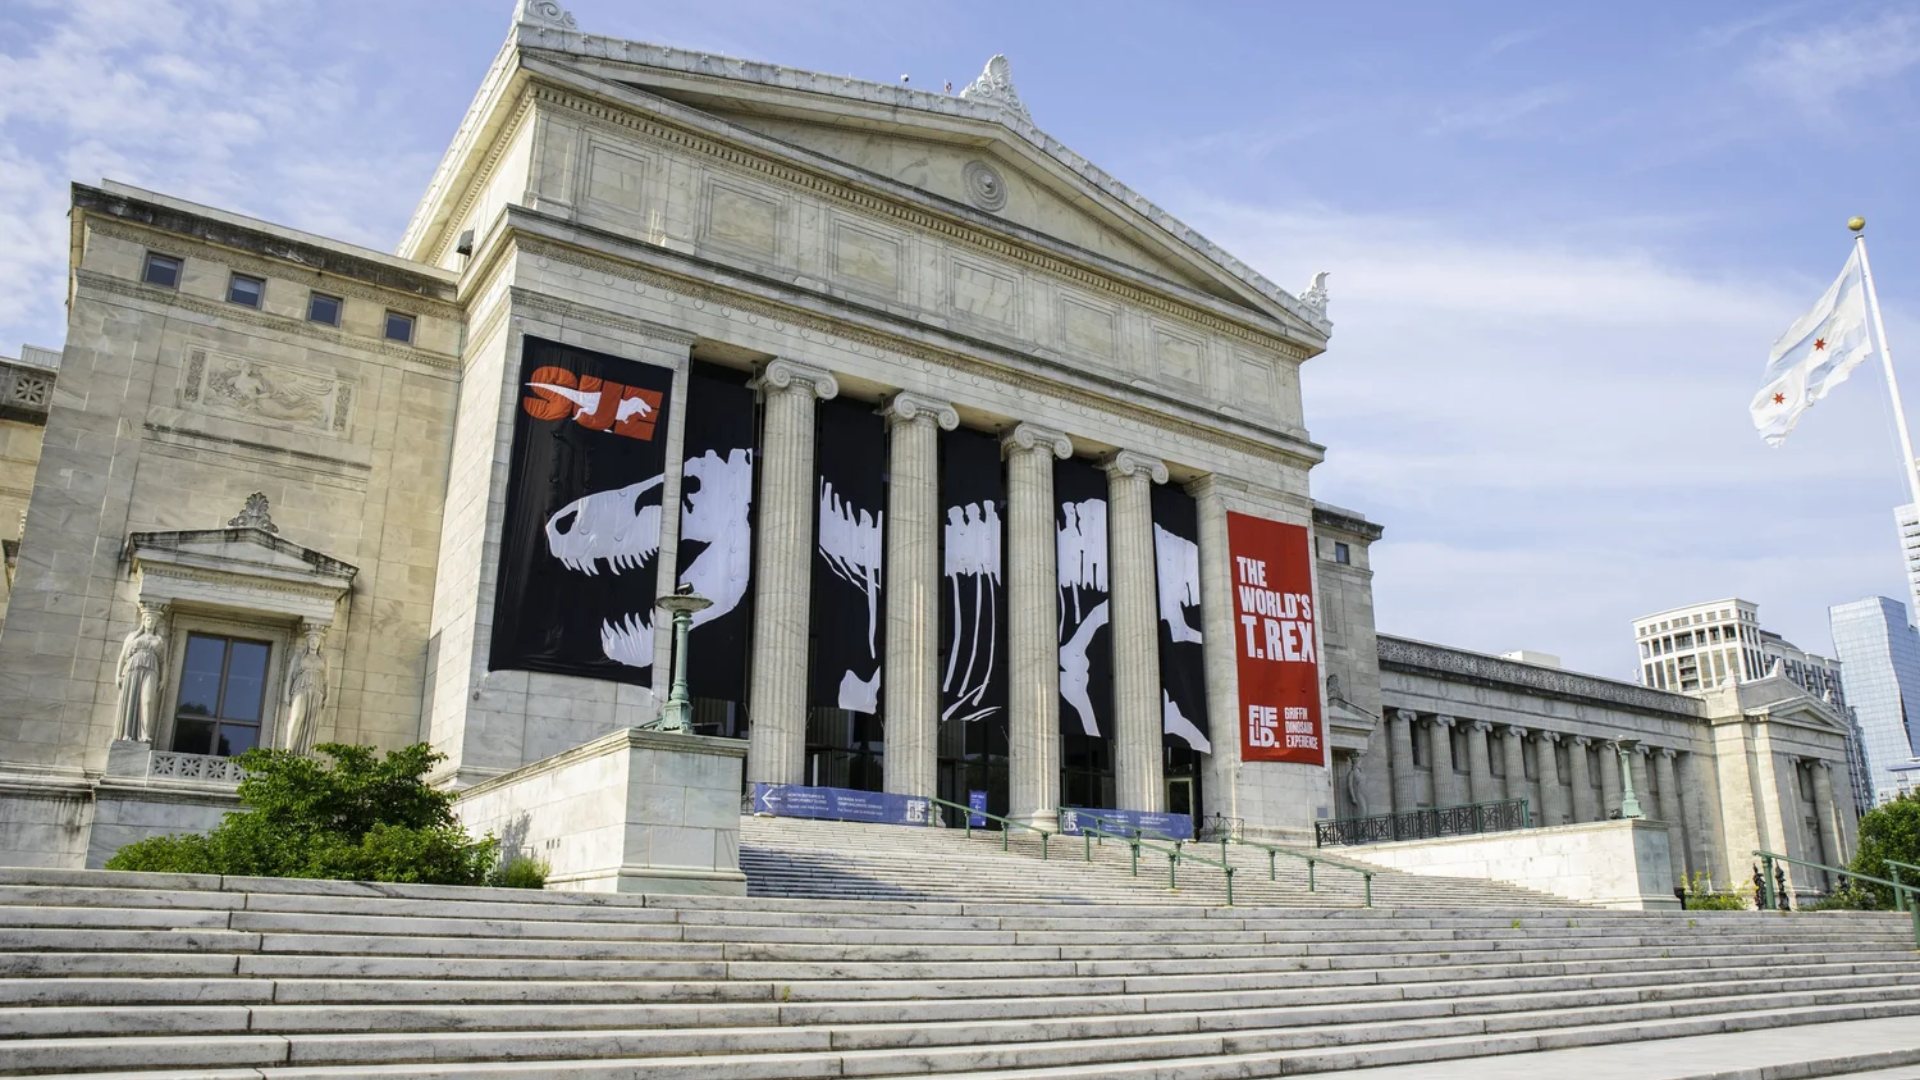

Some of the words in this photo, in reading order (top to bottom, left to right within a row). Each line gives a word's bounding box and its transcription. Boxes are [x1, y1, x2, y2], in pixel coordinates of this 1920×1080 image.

[523, 365, 664, 442] SUE
[1236, 556, 1267, 587] THE
[1238, 585, 1312, 621] WORLD'S
[1241, 614, 1316, 664] T.REX
[1285, 734, 1318, 750] EXPERIENCE
